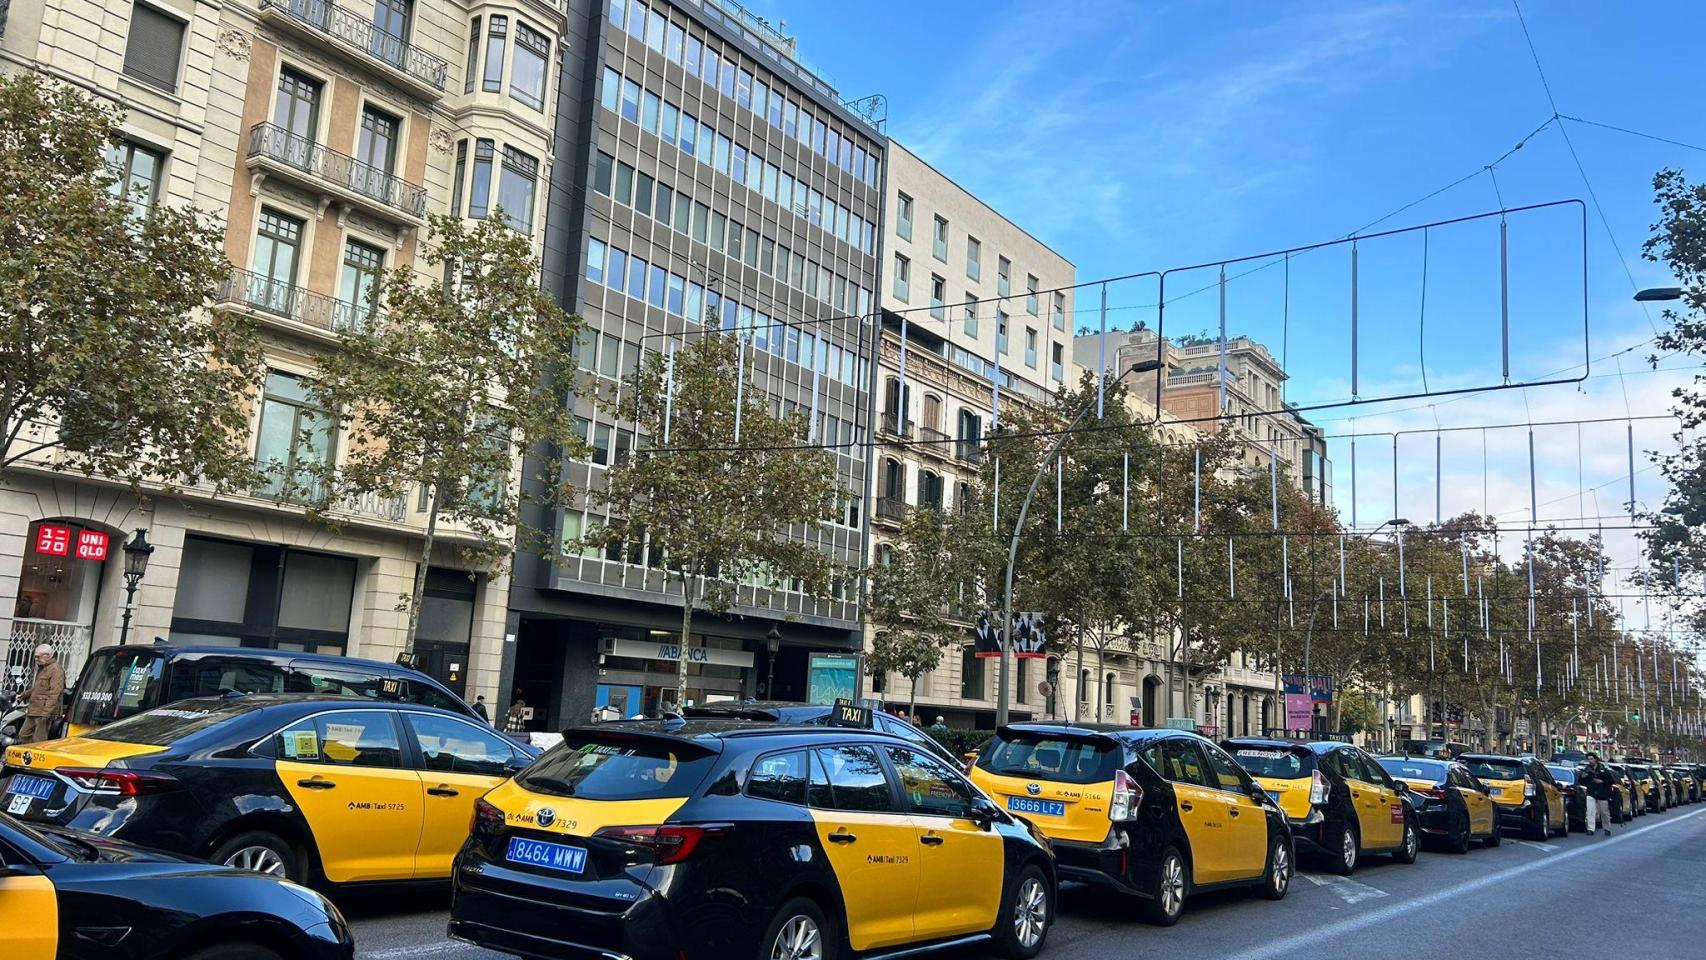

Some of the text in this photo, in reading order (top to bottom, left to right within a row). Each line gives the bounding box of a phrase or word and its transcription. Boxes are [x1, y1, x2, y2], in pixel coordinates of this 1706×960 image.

[42, 528, 65, 540] ユニ
[81, 534, 104, 546] UNI
[40, 540, 65, 552] クロ
[80, 545, 103, 556] QLO
[383, 681, 398, 692] TAXI
[842, 707, 861, 722] TAXI
[11, 796, 29, 811] SP
[1014, 798, 1063, 815] 3666 LFZ
[521, 815, 534, 823] AMB
[555, 818, 578, 829] 7329
[516, 841, 584, 870] 8464 MWW
